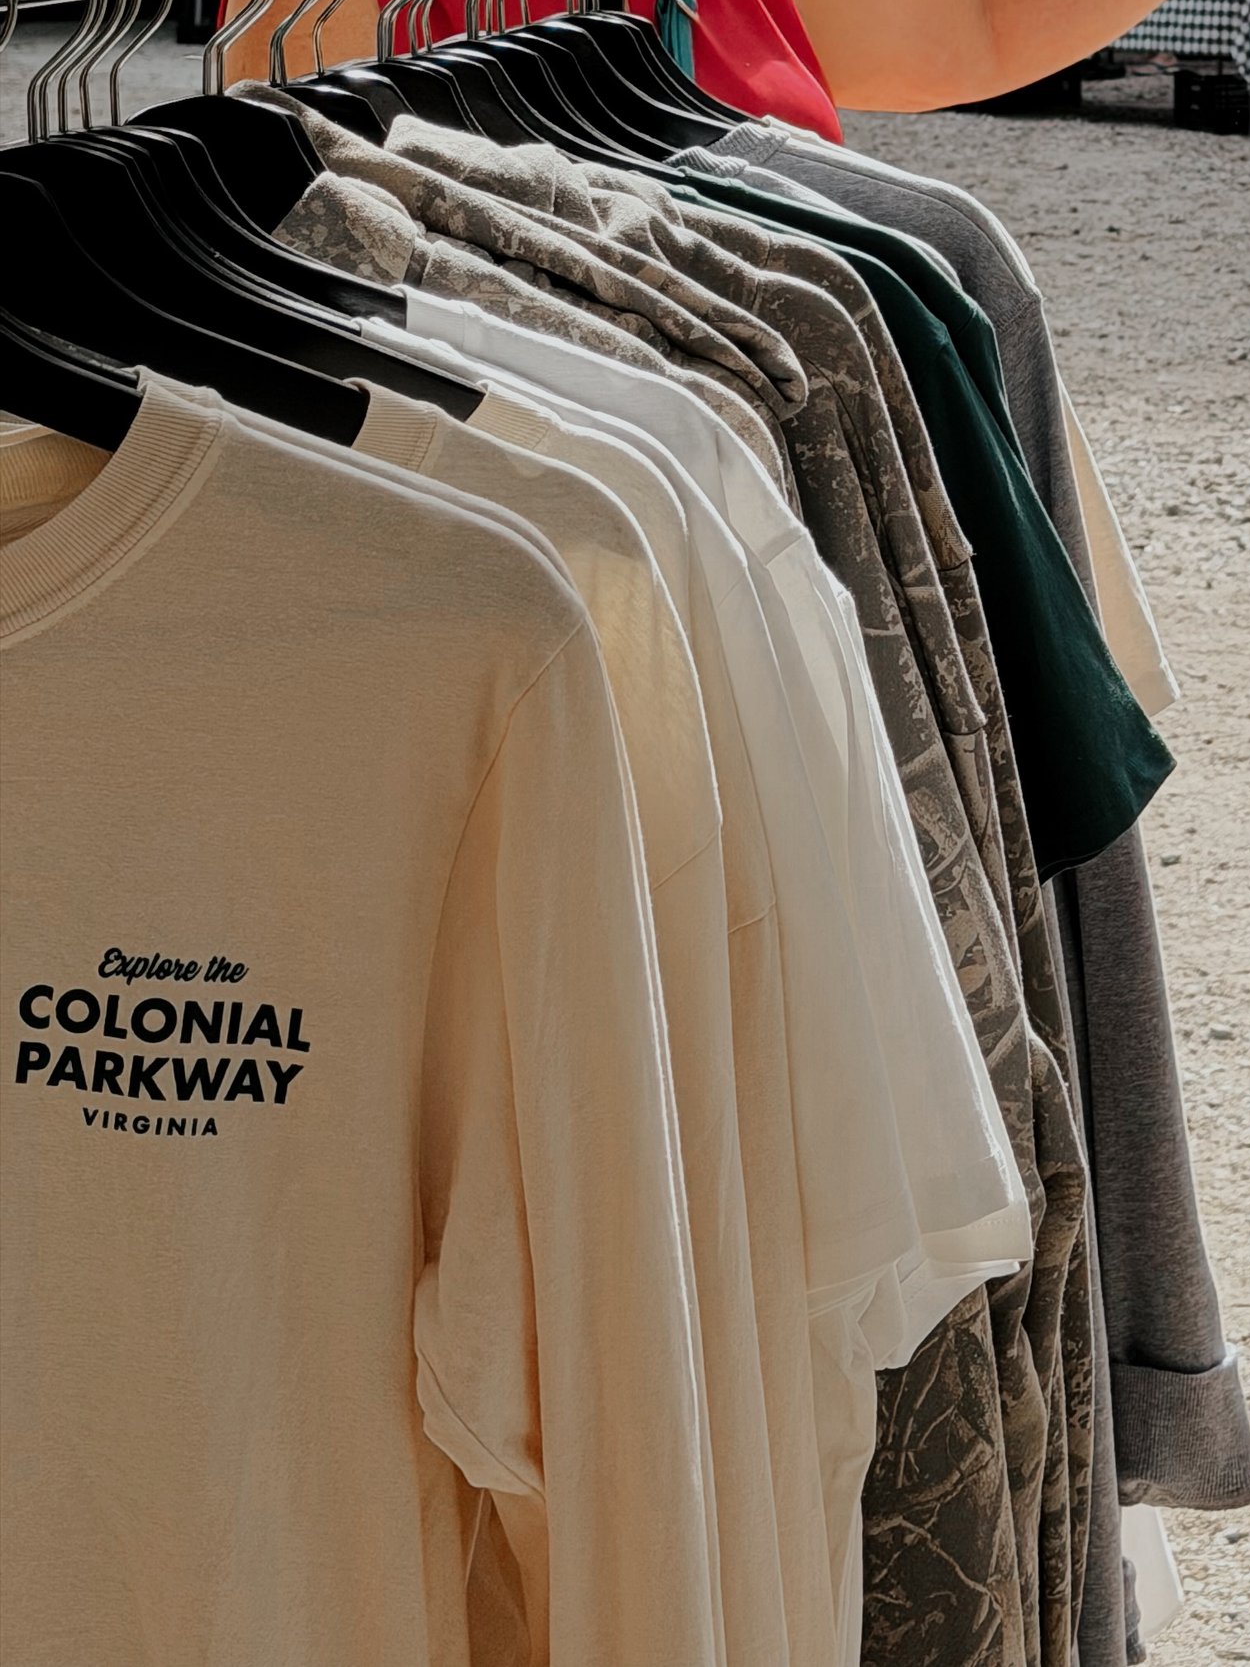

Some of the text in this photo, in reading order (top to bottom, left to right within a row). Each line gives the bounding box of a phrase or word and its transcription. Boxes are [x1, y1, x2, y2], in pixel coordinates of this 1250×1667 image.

[98, 947, 249, 986] Explore the
[19, 984, 311, 1053] COLONIAL
[15, 1041, 304, 1104] PARKWAY
[82, 1107, 219, 1136] VIRGINIA
